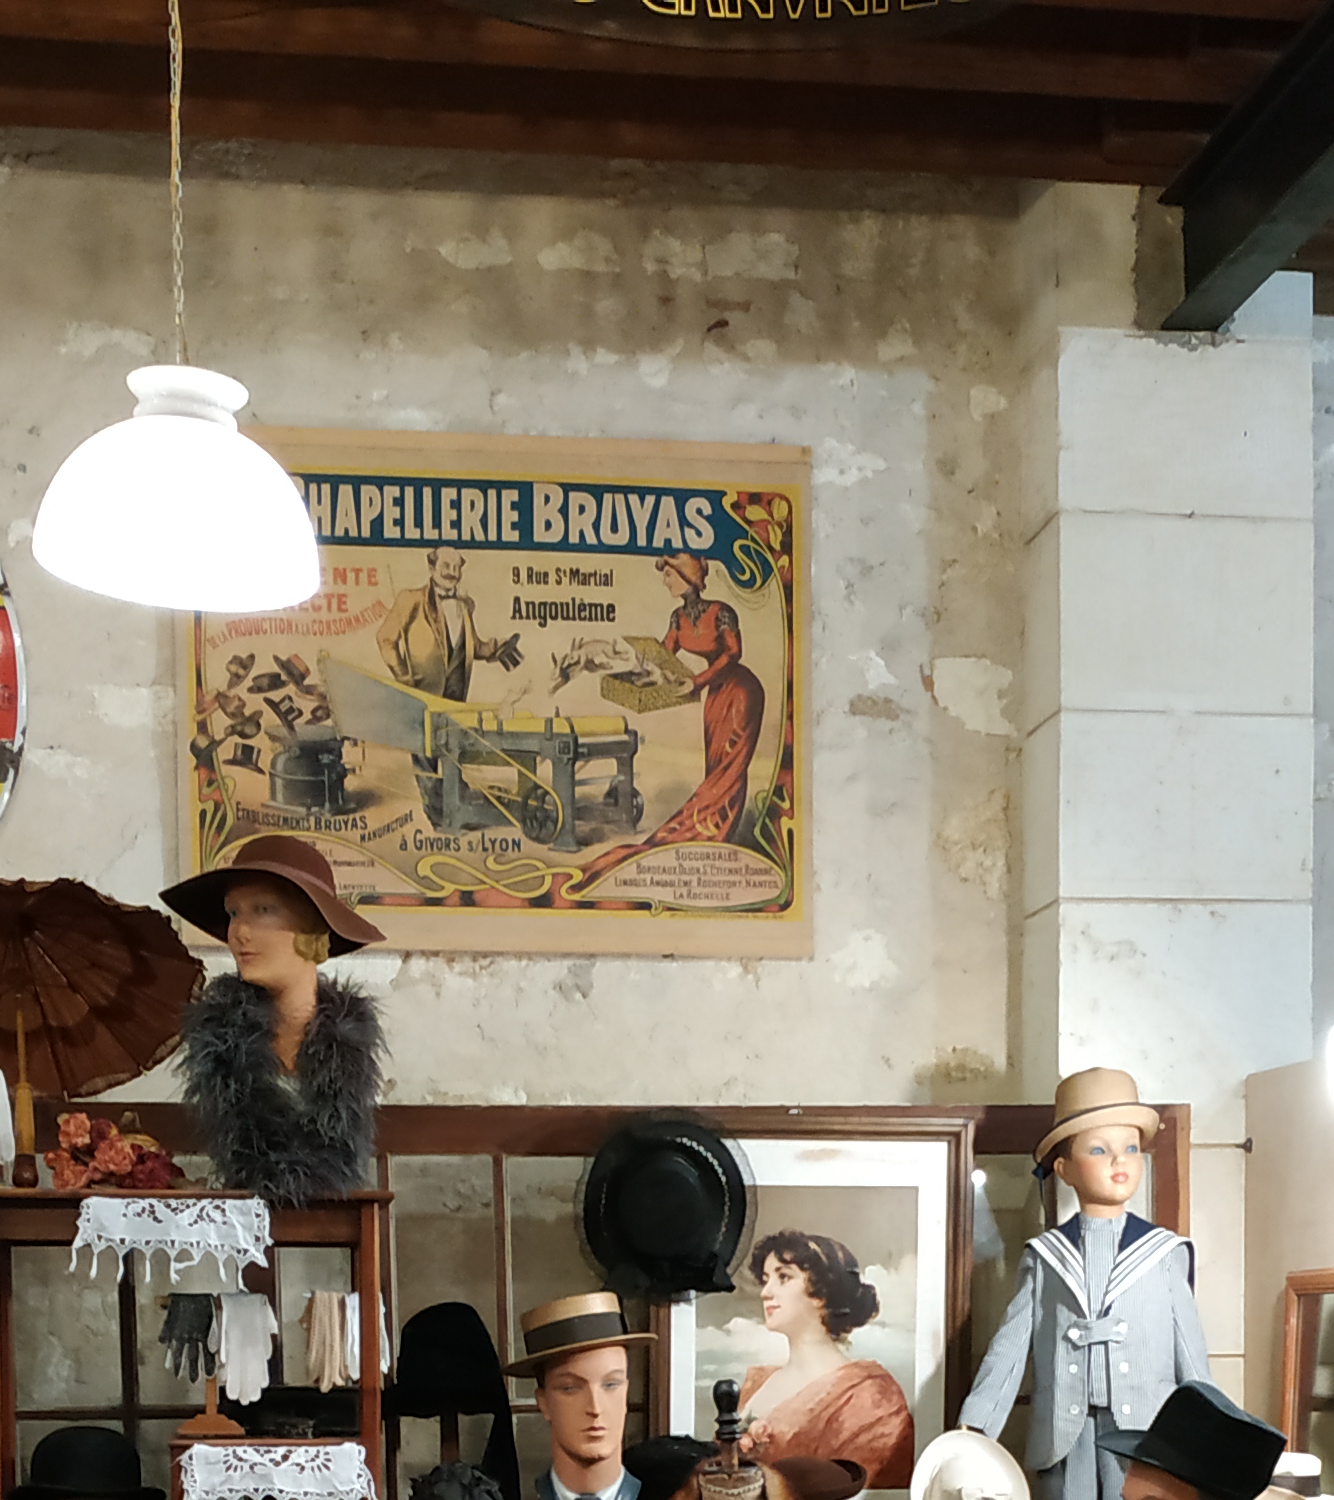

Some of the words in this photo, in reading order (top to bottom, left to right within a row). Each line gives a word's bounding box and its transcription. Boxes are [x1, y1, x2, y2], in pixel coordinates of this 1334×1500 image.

[526, 566, 549, 586] Rue
[568, 567, 614, 588] Martial
[225, 617, 293, 640] PRODUCTION
[311, 598, 389, 637] CONSOMMATION
[359, 809, 414, 845] MANUFACTURE
[399, 834, 408, 852] à
